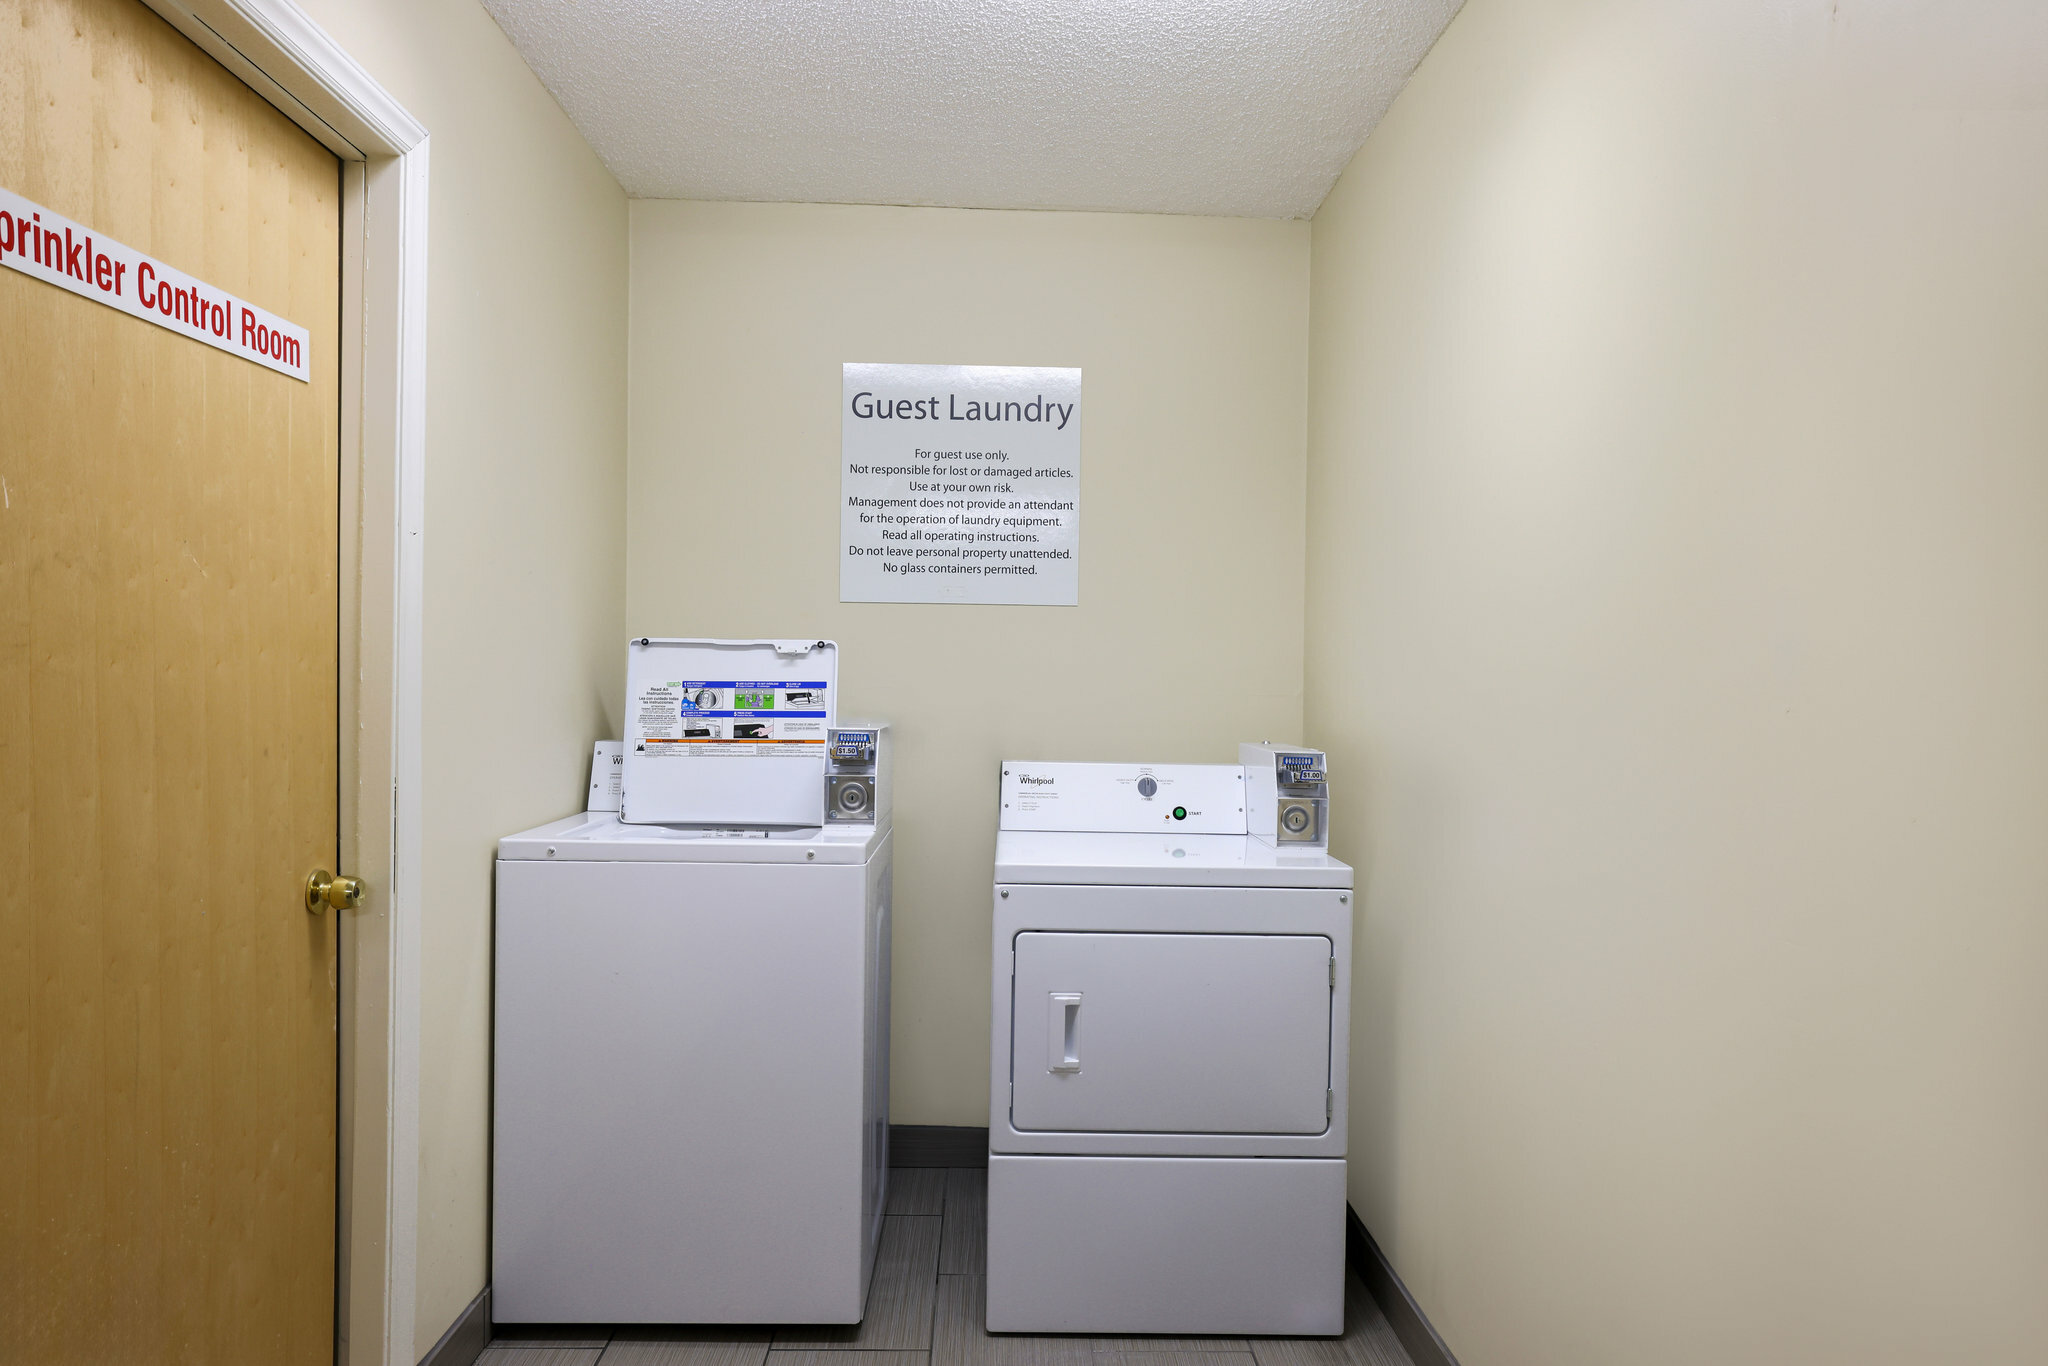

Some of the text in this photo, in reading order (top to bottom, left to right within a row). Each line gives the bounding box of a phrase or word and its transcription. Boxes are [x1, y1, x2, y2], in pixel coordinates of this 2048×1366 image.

[137, 261, 231, 341] Control
[241, 306, 301, 369] Room
[852, 392, 1074, 430] Guest Laundry
[914, 448, 1009, 464] For guest use only.
[849, 464, 1073, 480] Not responsible for lost or damaged articles.
[909, 481, 1013, 495] Use at your own risk.
[848, 497, 1074, 512] Management does not provide an attendant
[859, 512, 1061, 529] for the operation of laundry equipment.
[882, 529, 1039, 544] Read all operating instructions.
[848, 545, 1071, 561] Do not leave personal property unattended.
[883, 562, 1037, 578] No glass containers permitted.
[1019, 777, 1055, 786] Whirlpool
